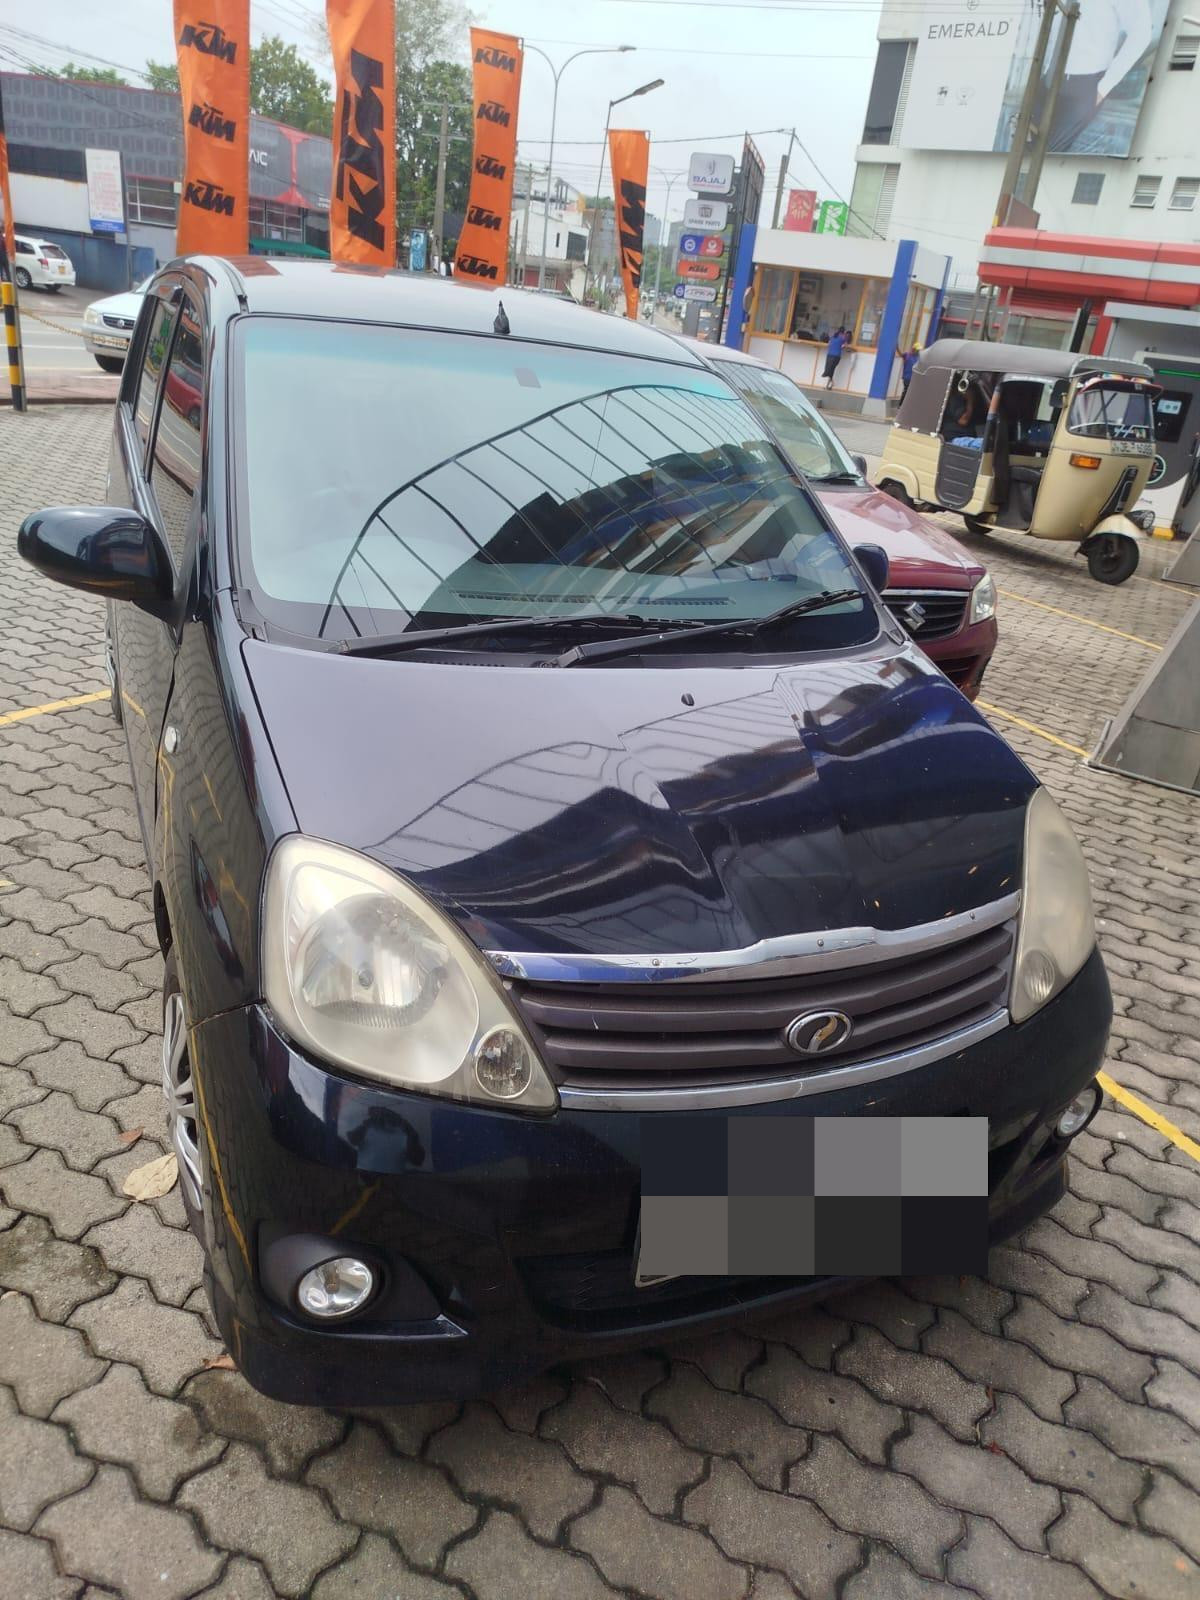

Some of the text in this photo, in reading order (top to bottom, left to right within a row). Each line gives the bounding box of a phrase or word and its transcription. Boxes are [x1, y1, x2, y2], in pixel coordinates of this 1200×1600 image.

[179, 22, 237, 65] KTM
[927, 20, 1010, 40] EMERALD
[475, 46, 516, 73] KTM
[188, 103, 236, 143] KTM
[476, 101, 510, 128] KTM
[475, 154, 506, 181] KTM
[692, 175, 726, 185] BAJAJ
[183, 180, 235, 216] KTM
[467, 205, 502, 232] KTM
[457, 253, 498, 280] KTM
